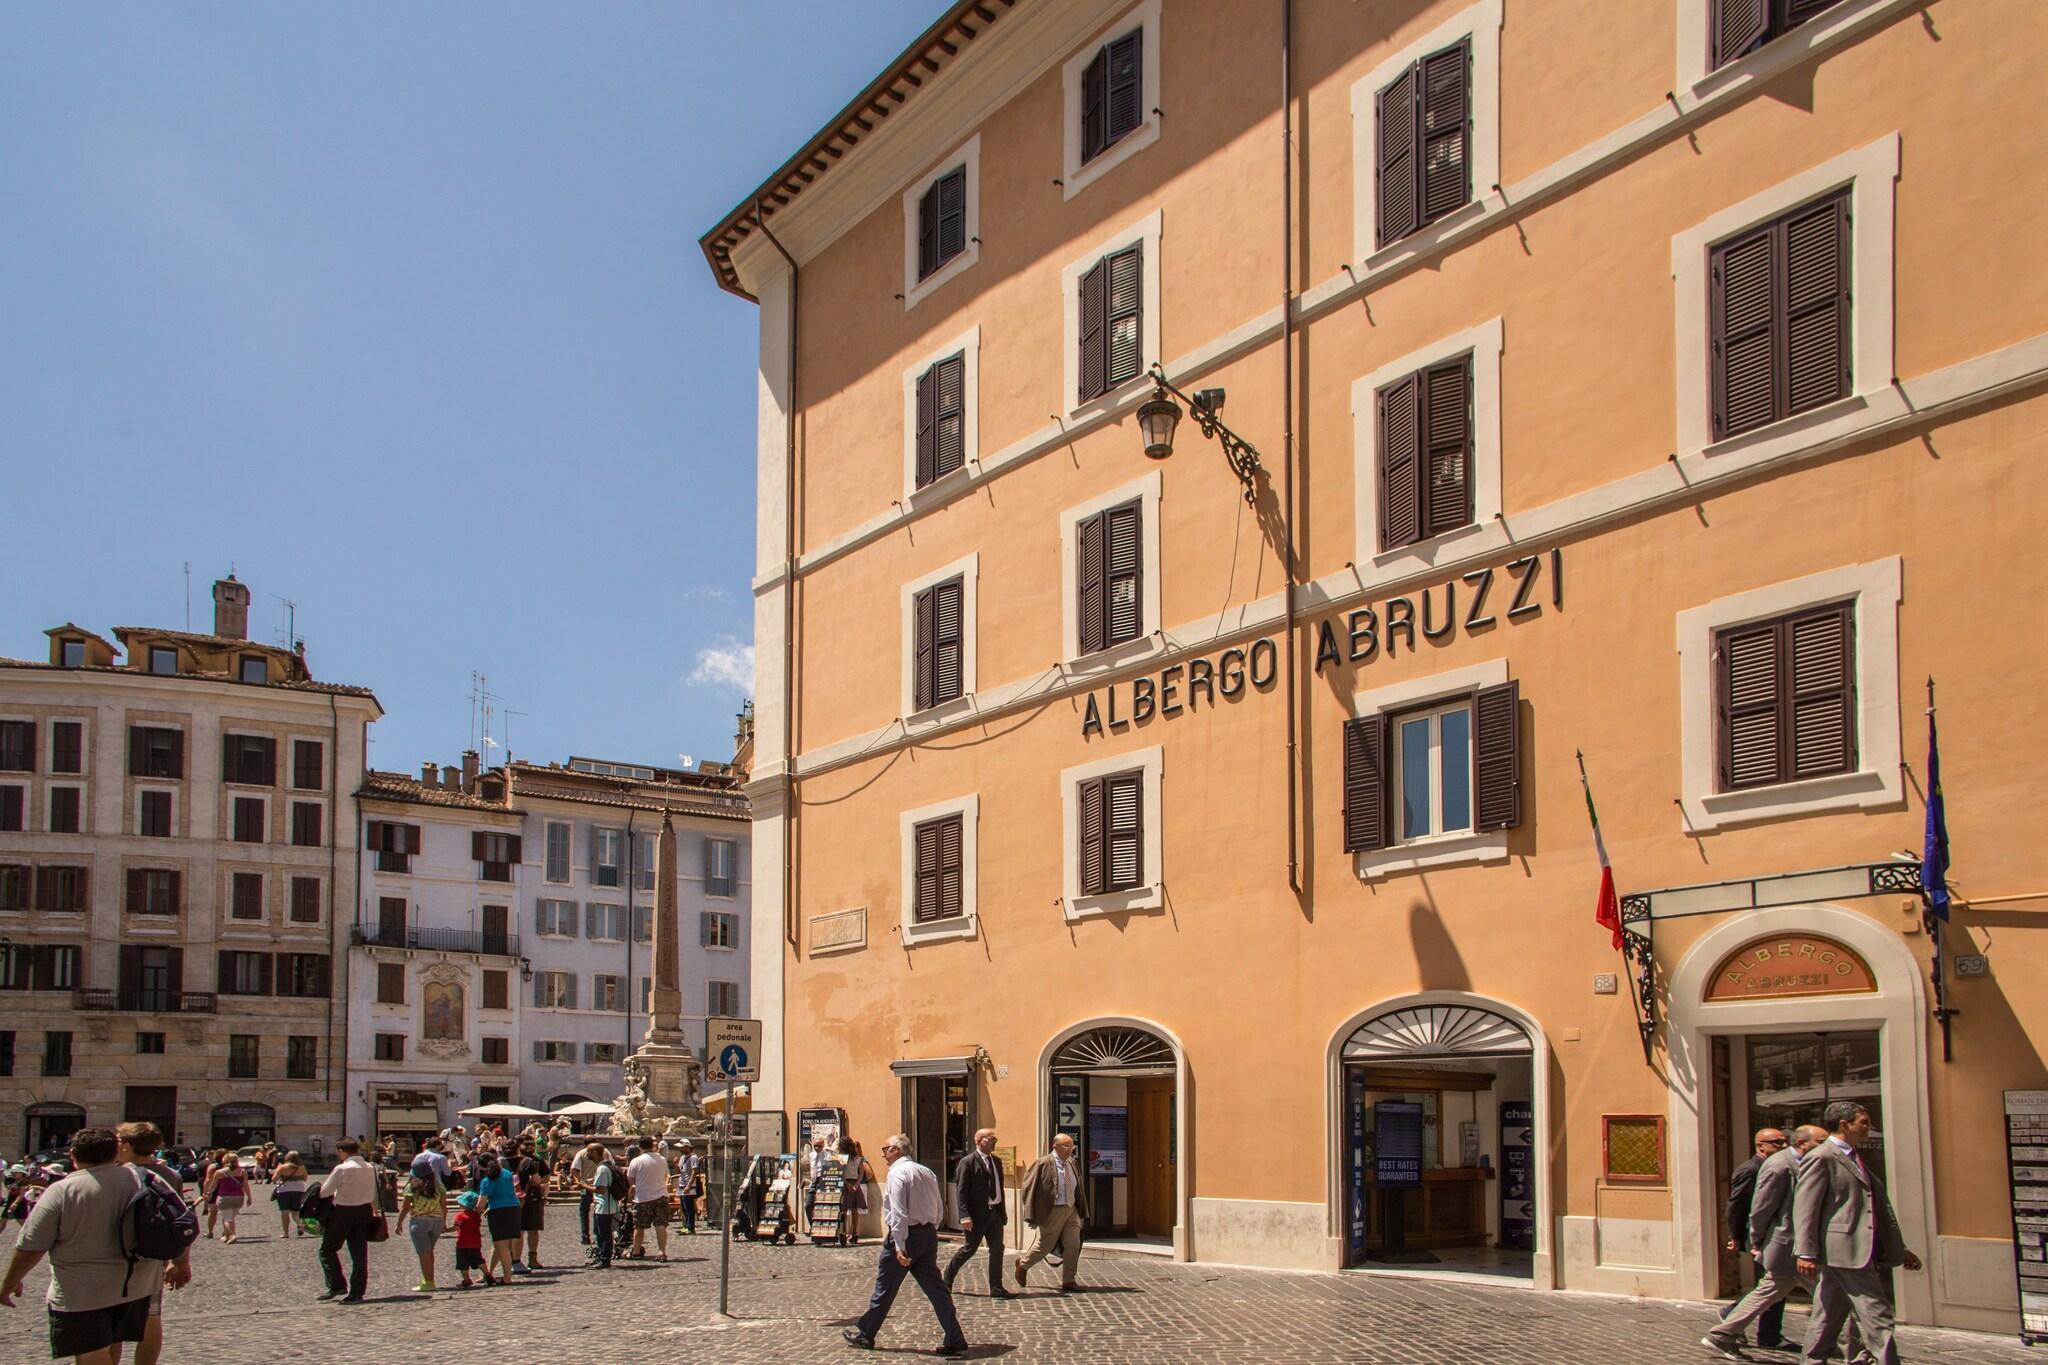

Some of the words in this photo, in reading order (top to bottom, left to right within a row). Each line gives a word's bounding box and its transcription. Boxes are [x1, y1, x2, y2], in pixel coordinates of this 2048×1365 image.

[1082, 637, 1277, 736] ALBERGO
[1314, 548, 1563, 672] ABRUZZI
[1727, 943, 1853, 985] ALBERGO
[1958, 957, 1982, 972] 69
[1745, 973, 1829, 989] ABRUZZI
[716, 1032, 752, 1042] pedonale
[1378, 1159, 1396, 1170] BEST
[1397, 1159, 1419, 1170] RATES
[1378, 1170, 1419, 1181] GUARANTEED
